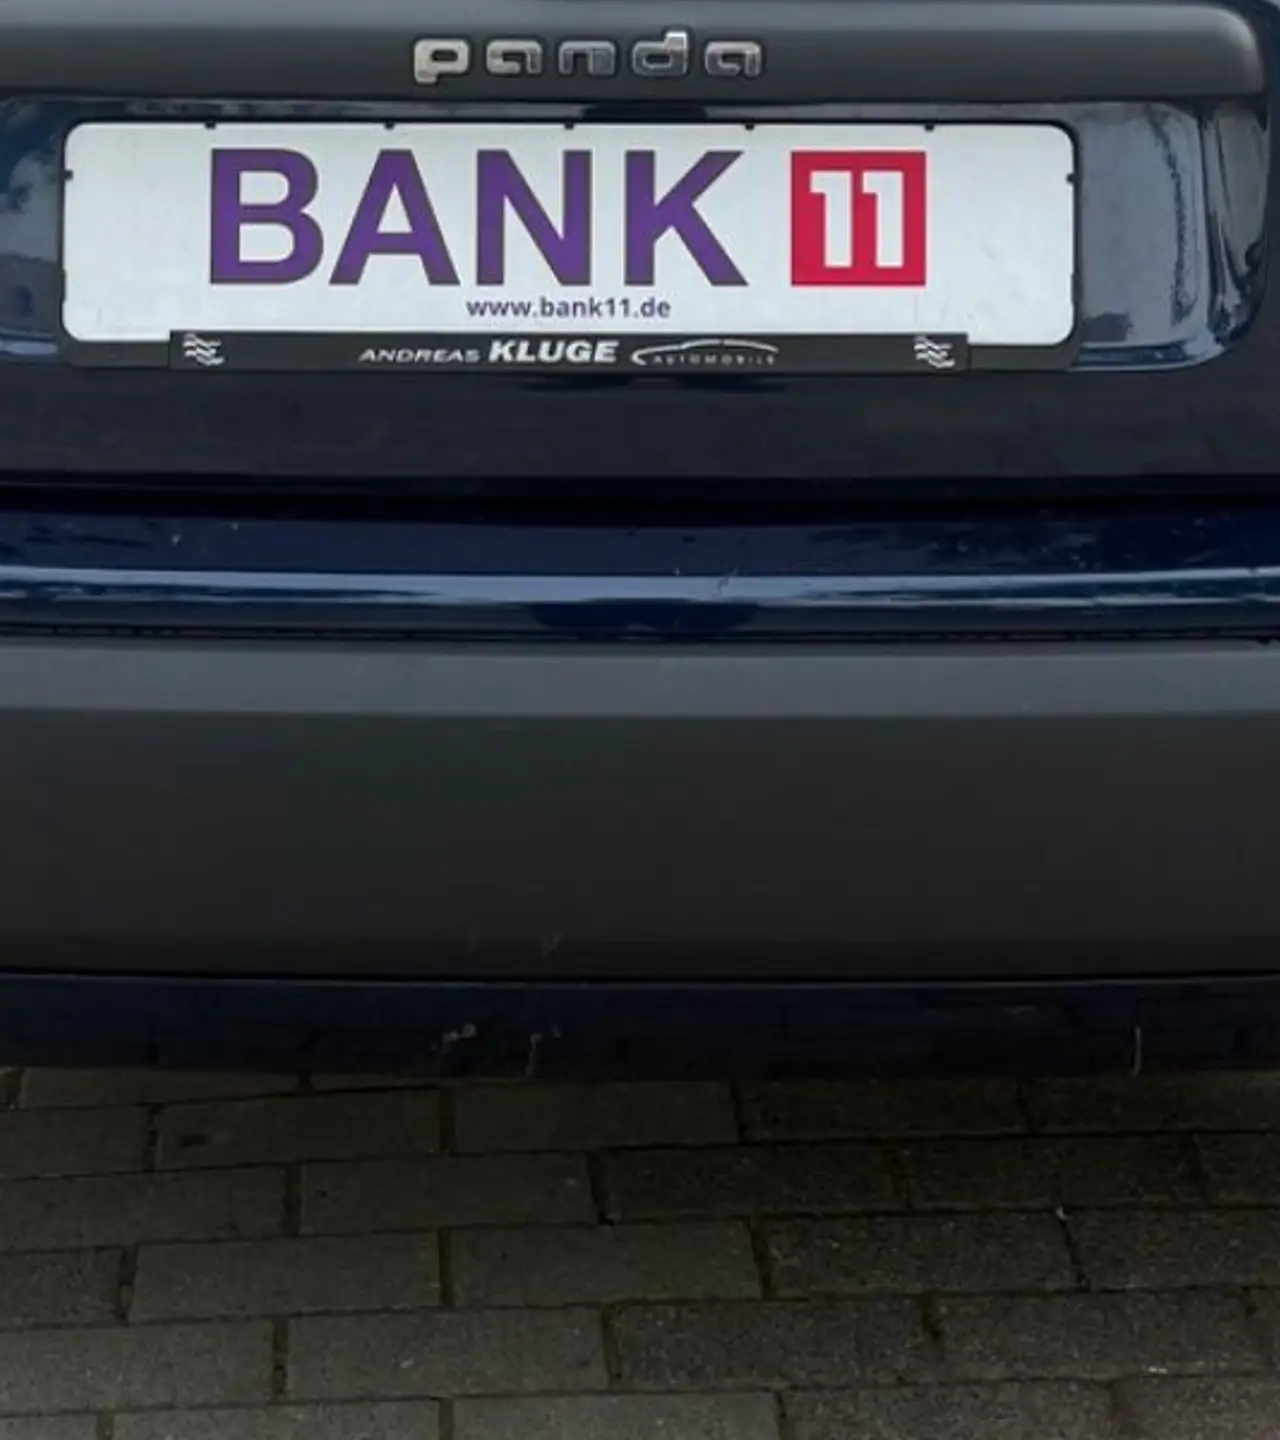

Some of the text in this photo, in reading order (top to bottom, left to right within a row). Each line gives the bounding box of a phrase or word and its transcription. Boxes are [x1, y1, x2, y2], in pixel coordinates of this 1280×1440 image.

[414, 31, 762, 84] panda
[210, 149, 904, 287] BANK 11
[467, 298, 671, 319] www.bank11.de
[358, 348, 481, 364] ANDREAS
[488, 340, 619, 363] KLUGE
